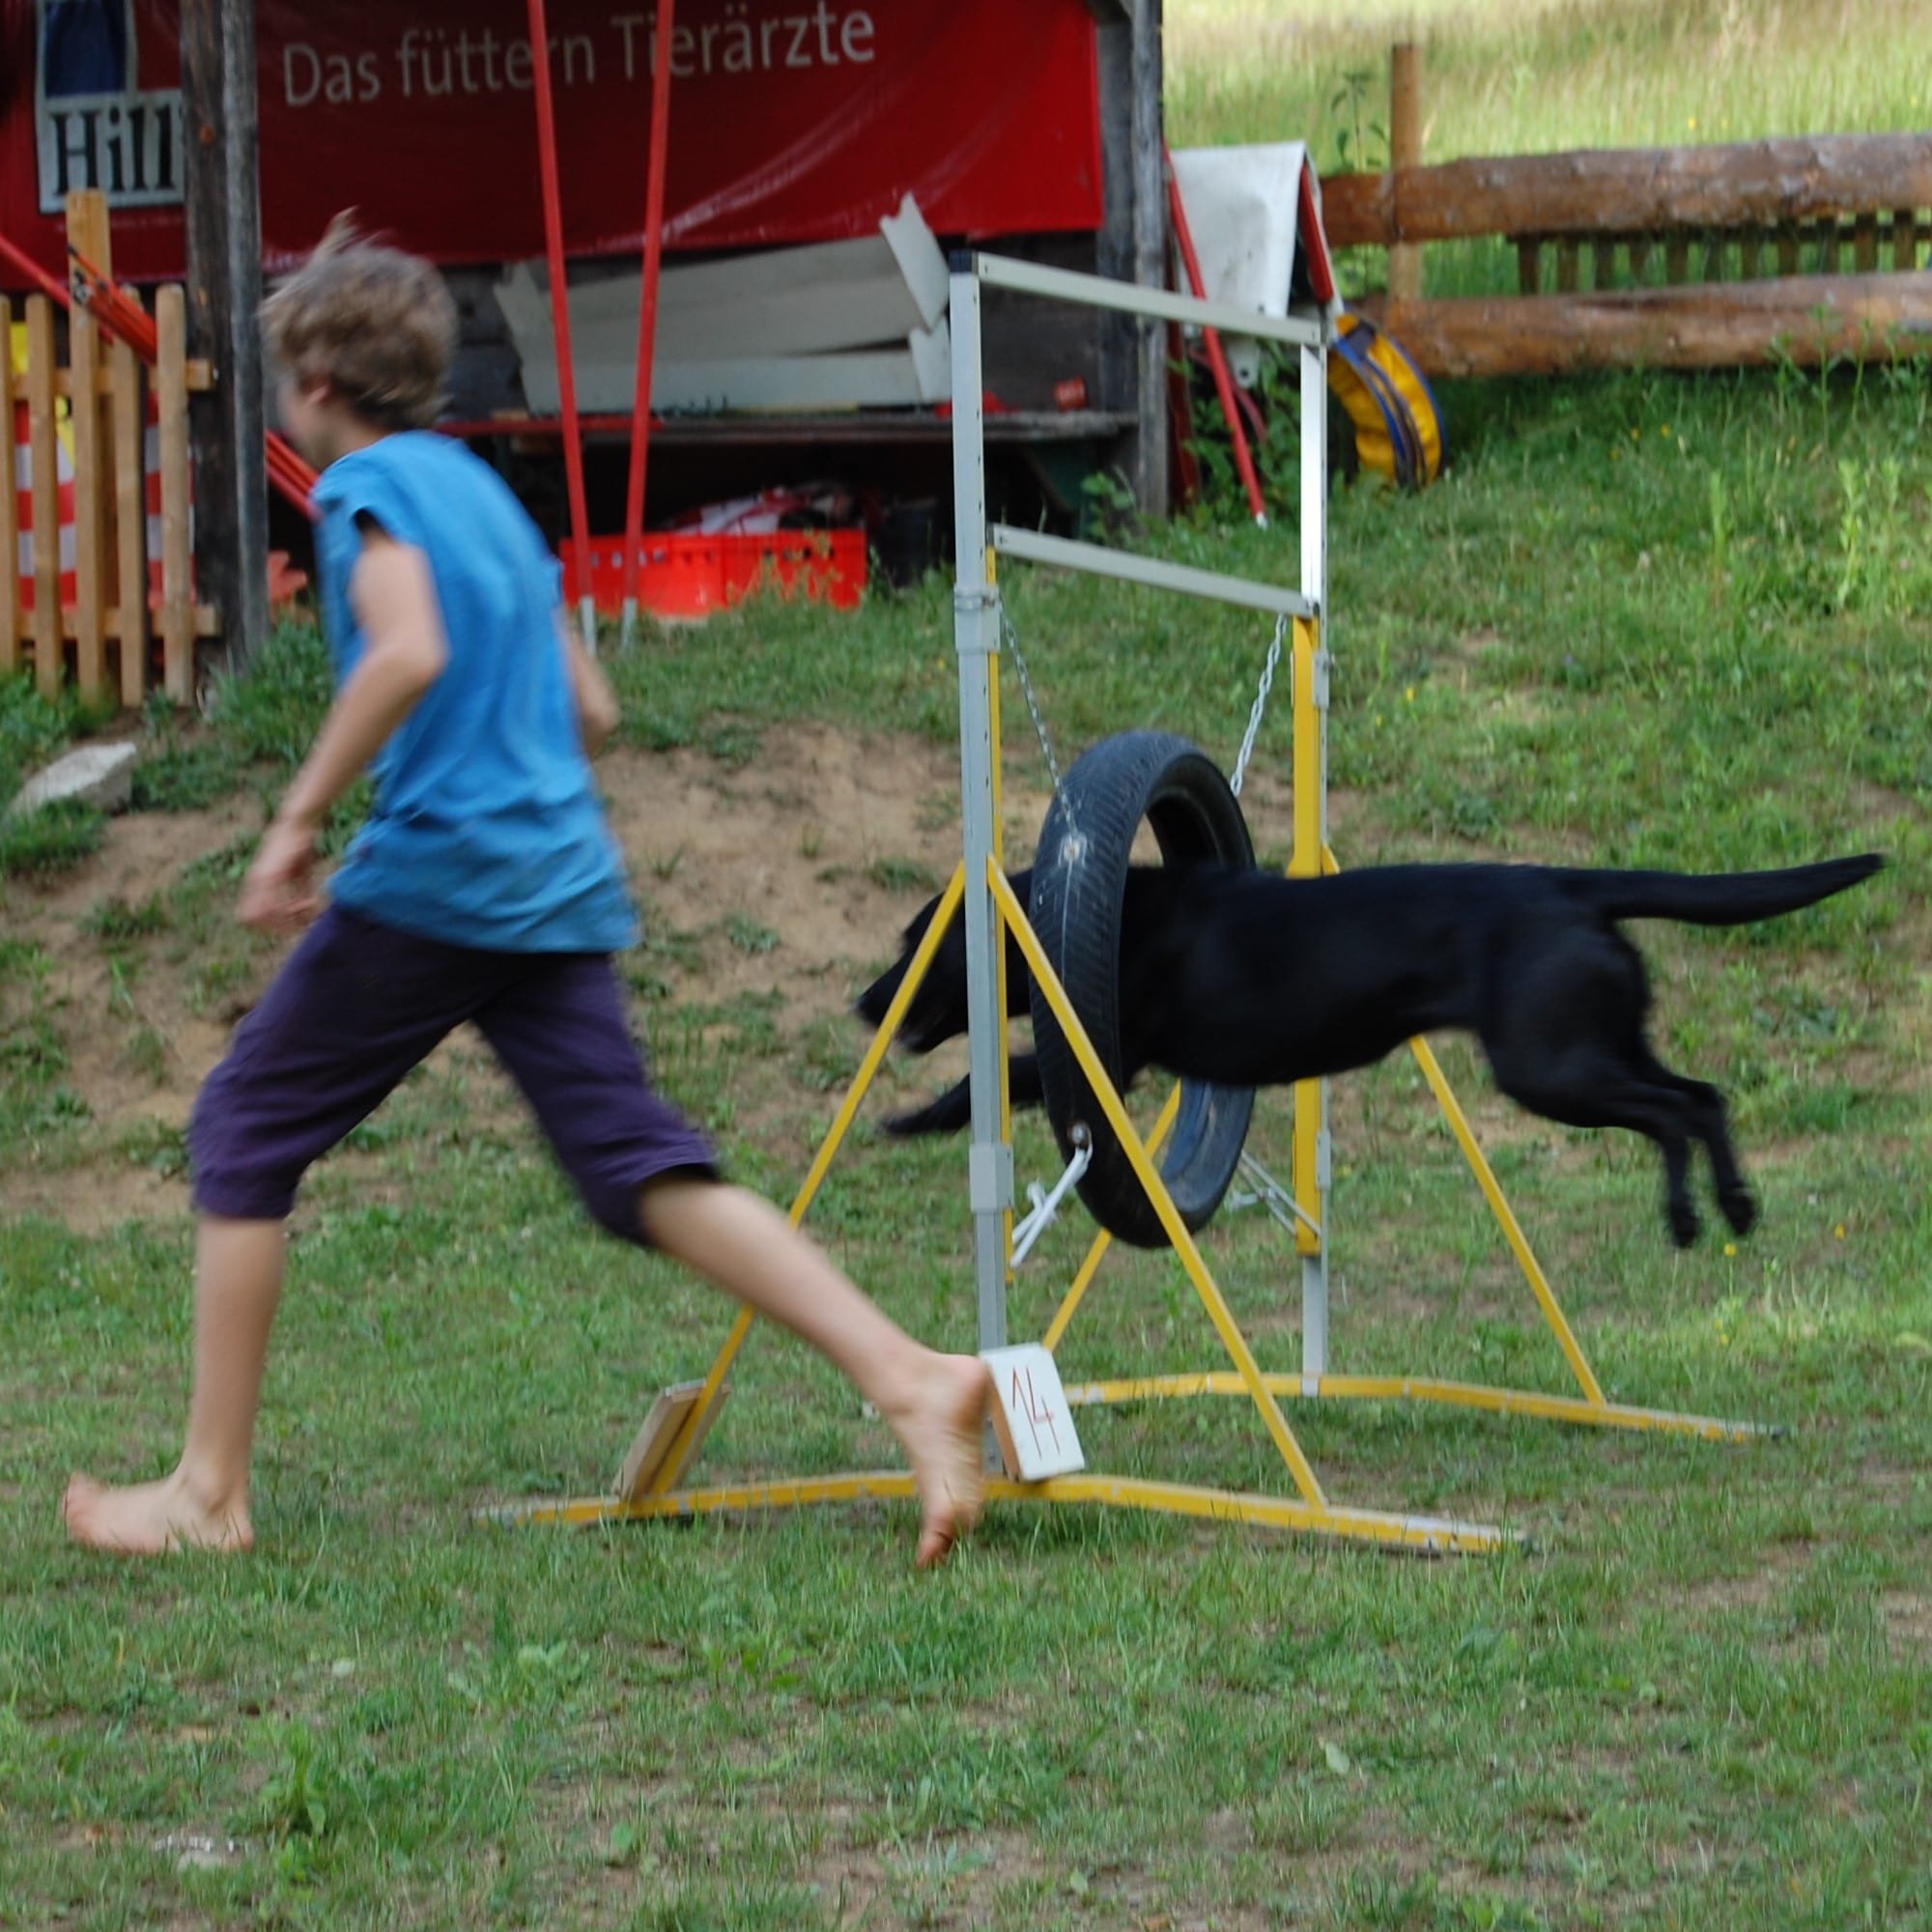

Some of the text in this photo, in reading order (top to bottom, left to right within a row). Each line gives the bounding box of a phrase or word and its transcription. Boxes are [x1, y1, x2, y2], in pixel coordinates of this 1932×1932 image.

[283, 43, 382, 107] Das
[610, 3, 875, 79] Tierärzte
[49, 103, 184, 195] Hill
[1011, 1365, 1061, 1461] 14
